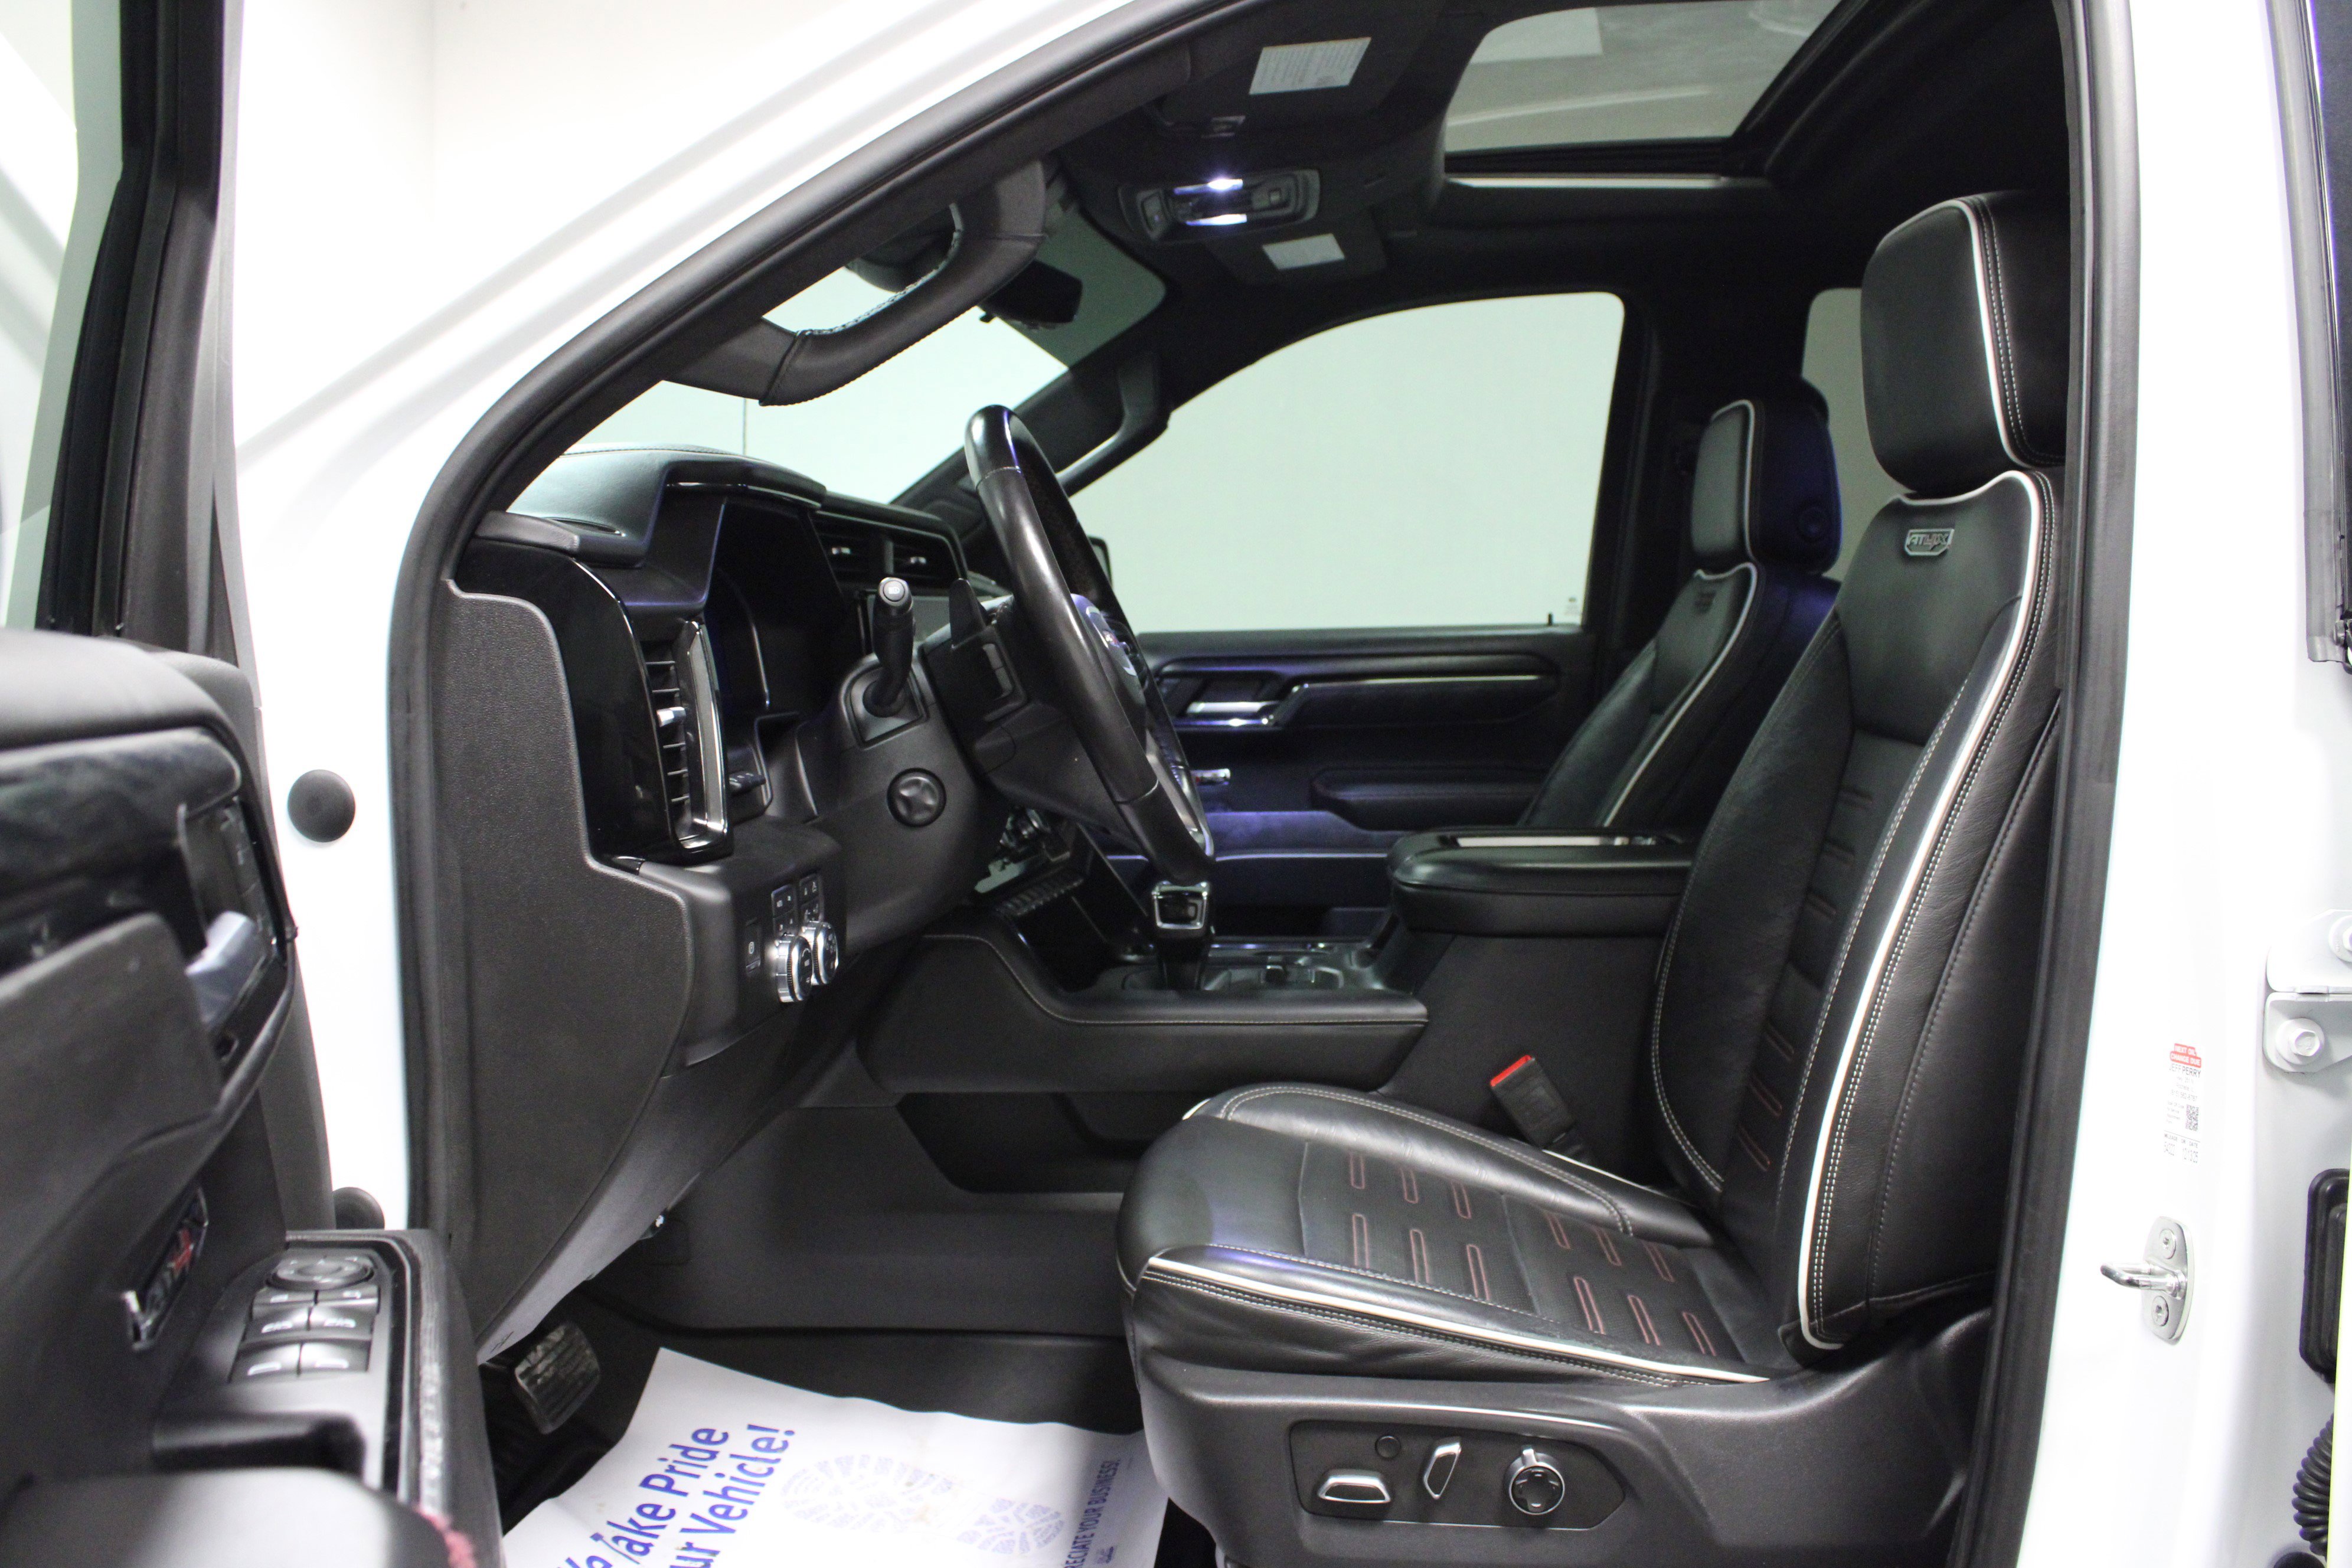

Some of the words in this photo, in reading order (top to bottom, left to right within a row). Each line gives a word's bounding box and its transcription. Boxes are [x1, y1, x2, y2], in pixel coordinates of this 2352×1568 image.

[2170, 1053, 2189, 1063] CHANGE
[2174, 1045, 2187, 1054] NEXT
[2188, 1048, 2196, 1056] OIL
[2164, 1133, 2178, 1142] MILEAGE
[638, 1427, 730, 1497] Pride
[679, 1423, 795, 1534] Vehicle!
[1077, 1506, 1105, 1533] YOUR
